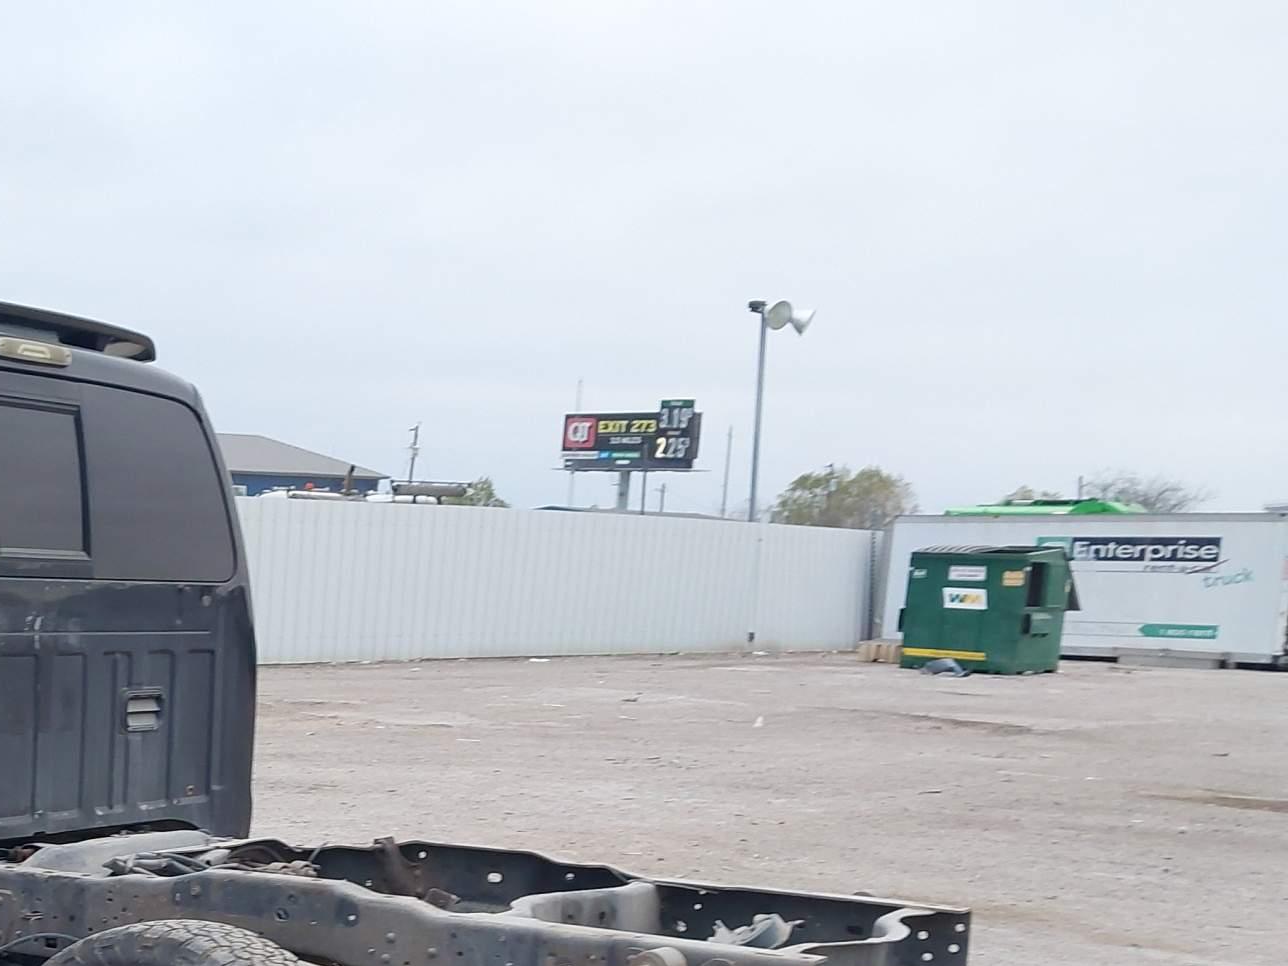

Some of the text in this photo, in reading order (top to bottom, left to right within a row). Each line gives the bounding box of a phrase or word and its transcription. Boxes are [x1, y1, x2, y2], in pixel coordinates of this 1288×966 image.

[597, 420, 657, 433] EXIT 273
[1072, 540, 1219, 562] Enterprise
